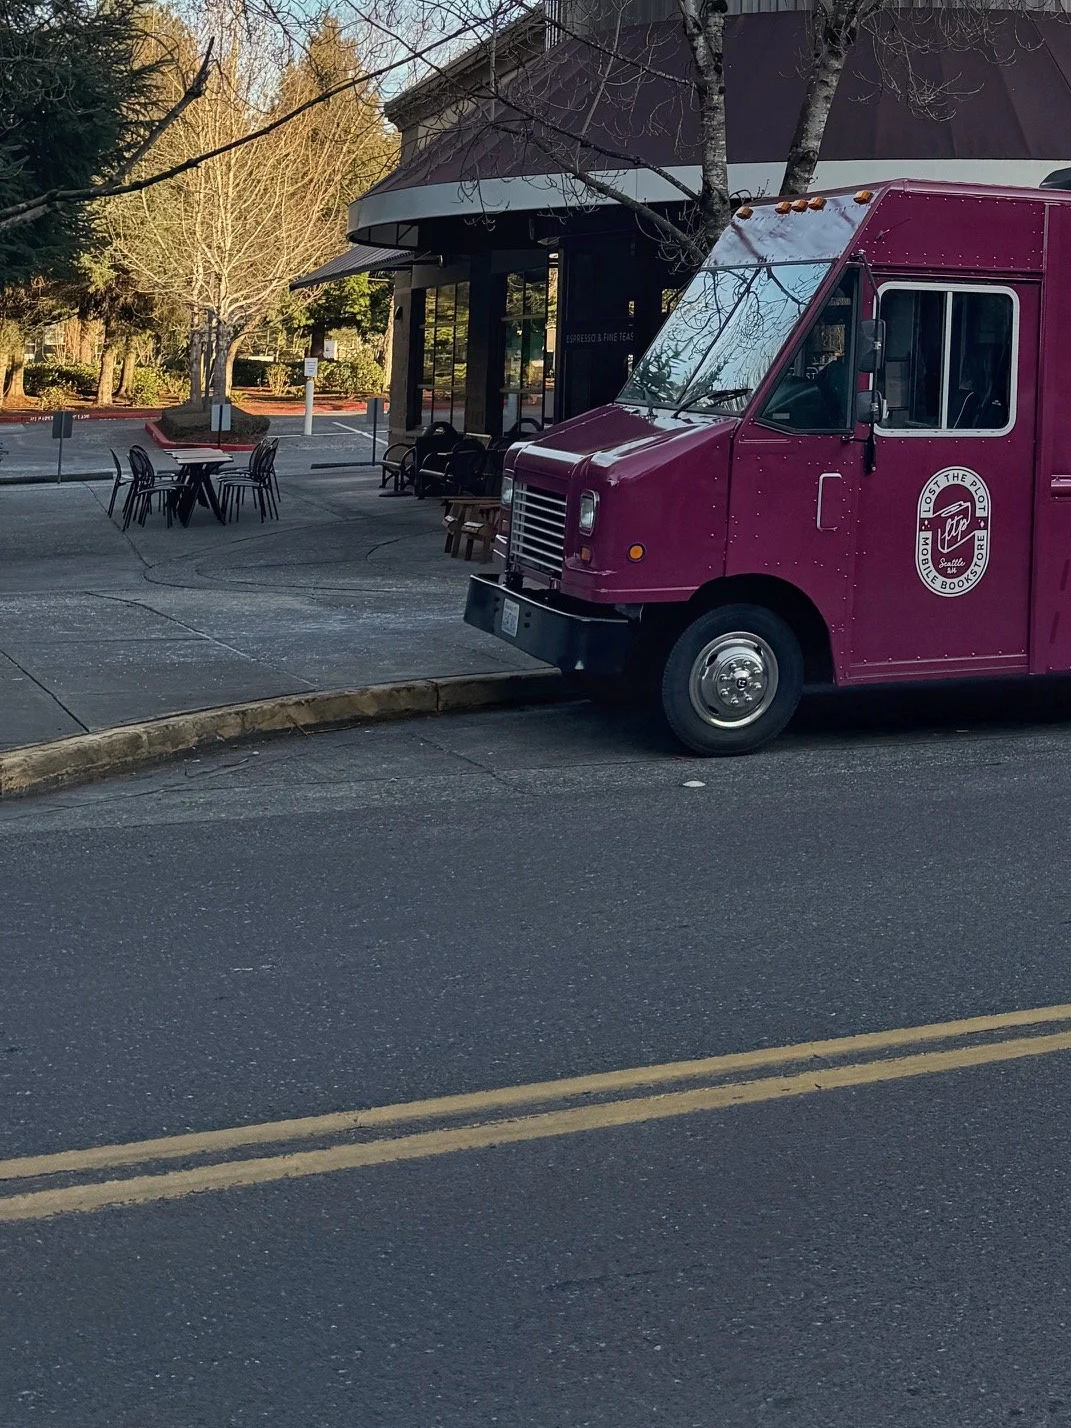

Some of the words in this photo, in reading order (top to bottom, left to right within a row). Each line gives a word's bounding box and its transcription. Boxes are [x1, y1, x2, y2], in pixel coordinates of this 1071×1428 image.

[566, 334, 596, 343] ESPRESSO
[603, 332, 617, 342] FINE
[619, 332, 634, 341] TEAS
[922, 480, 940, 513] LOST
[944, 473, 968, 483] THE
[969, 480, 986, 512] PLOT
[921, 537, 939, 584] MOBILE
[940, 535, 985, 590] BOOKSTORE
[939, 558, 966, 568] Seattle
